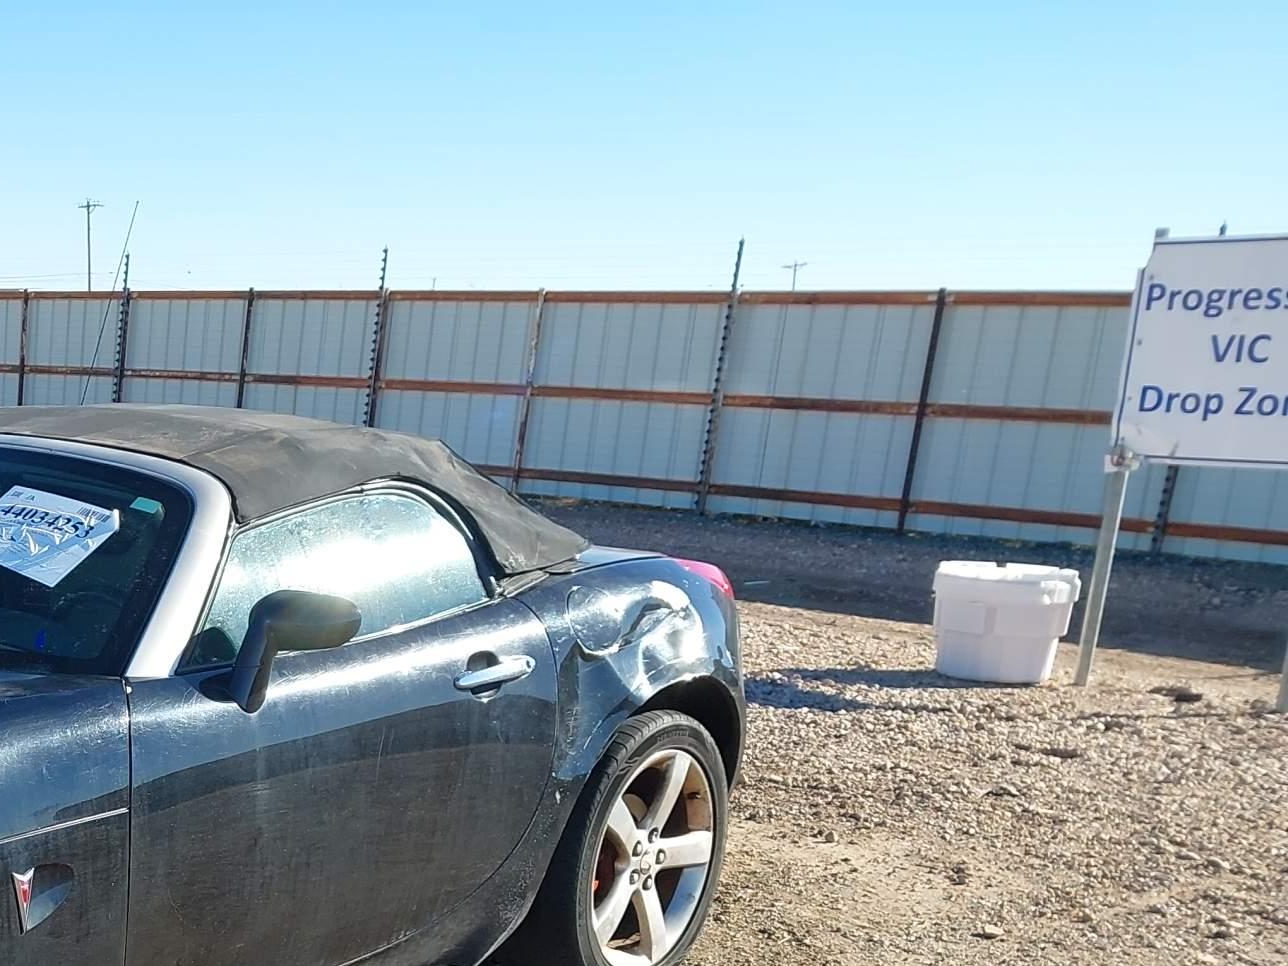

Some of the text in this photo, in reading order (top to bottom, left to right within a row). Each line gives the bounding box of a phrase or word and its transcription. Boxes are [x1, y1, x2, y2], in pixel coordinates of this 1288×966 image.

[1145, 283, 1288, 317] Progres
[1211, 334, 1271, 363] VIC
[1138, 385, 1224, 421] Drop
[1, 503, 95, 539] 44034253
